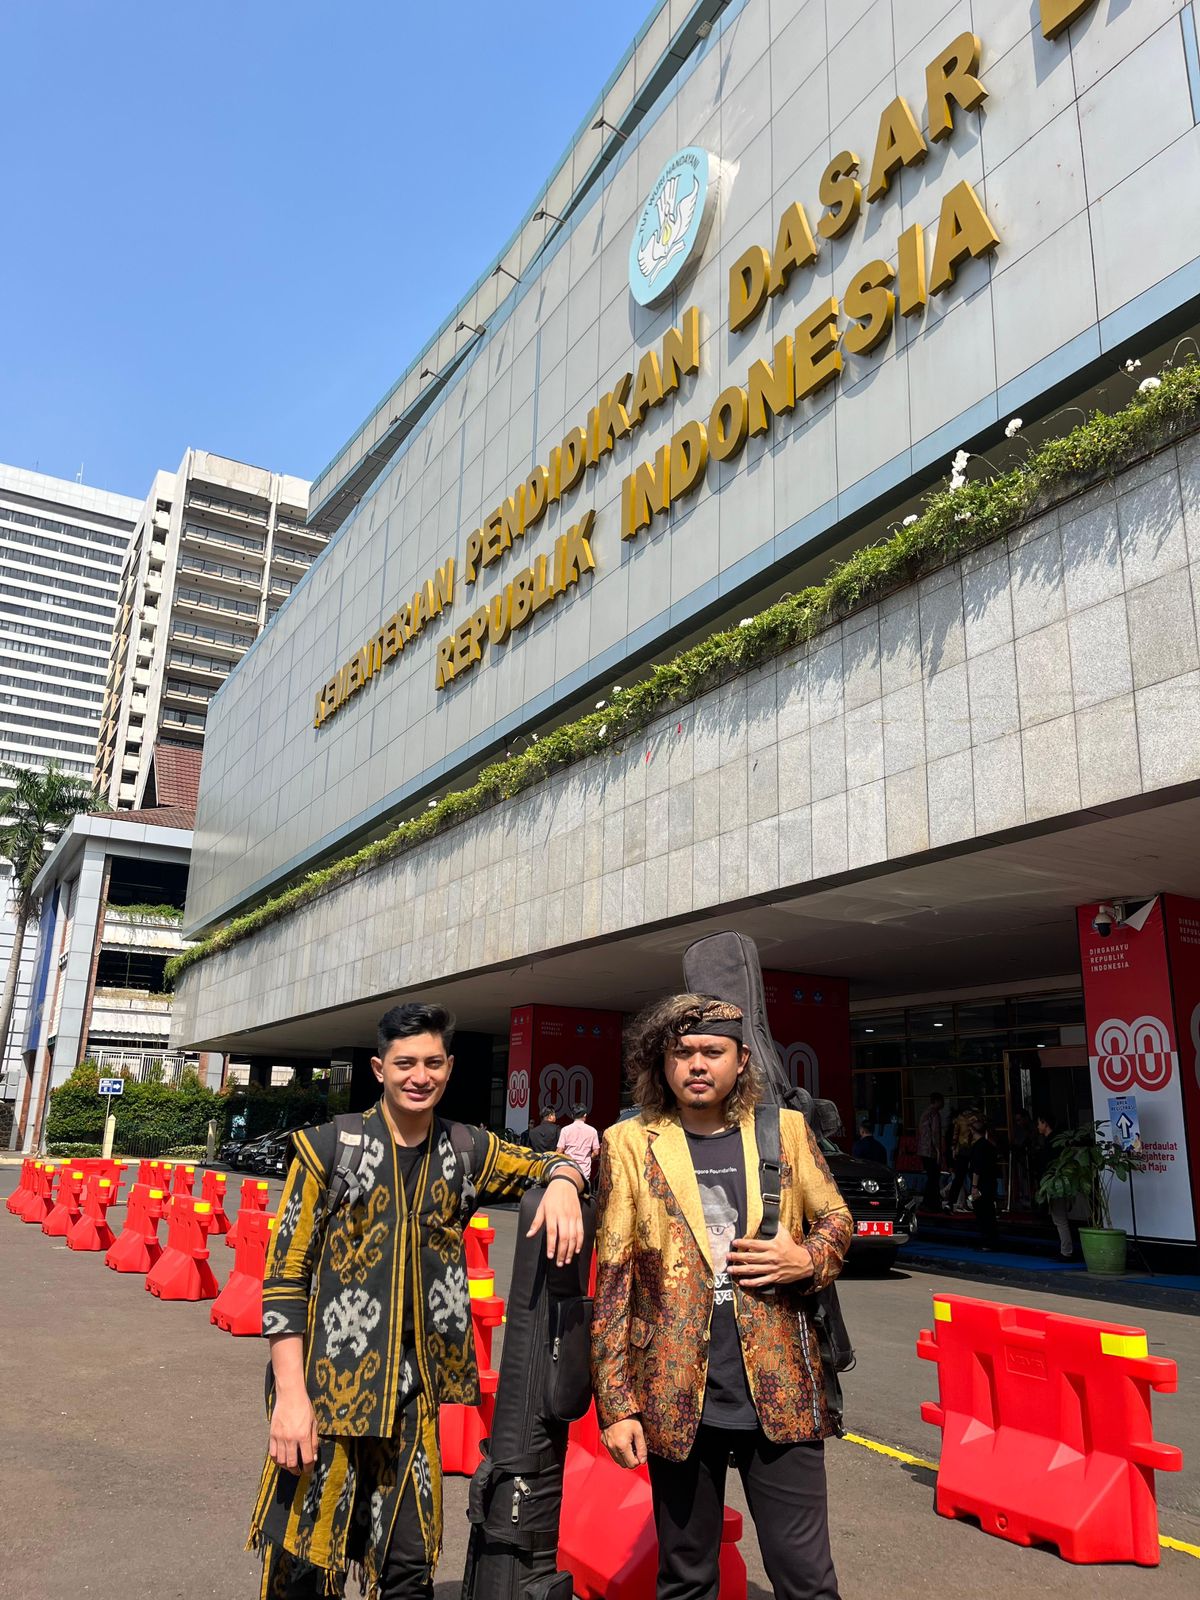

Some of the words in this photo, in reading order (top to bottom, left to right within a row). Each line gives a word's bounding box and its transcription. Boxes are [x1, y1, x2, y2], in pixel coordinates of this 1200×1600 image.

[639, 210, 649, 234] TUT
[648, 177, 666, 207] WURI
[666, 153, 701, 179] HANDAYANI
[313, 557, 454, 729] KEMENTERIAN
[465, 306, 699, 585] PENDIDIKAN
[728, 31, 989, 333] DASAR
[435, 509, 596, 690] REPUBLIK
[621, 179, 1000, 541] INDONESIA
[1089, 944, 1129, 955] DIRGAHAYU
[1090, 953, 1124, 964] REPUBLIK
[1091, 961, 1129, 972] INDONESIA
[1095, 1015, 1173, 1093] 80
[508, 1069, 528, 1109] 80
[538, 1063, 593, 1119] 80
[1148, 1162, 1167, 1173] Maju
